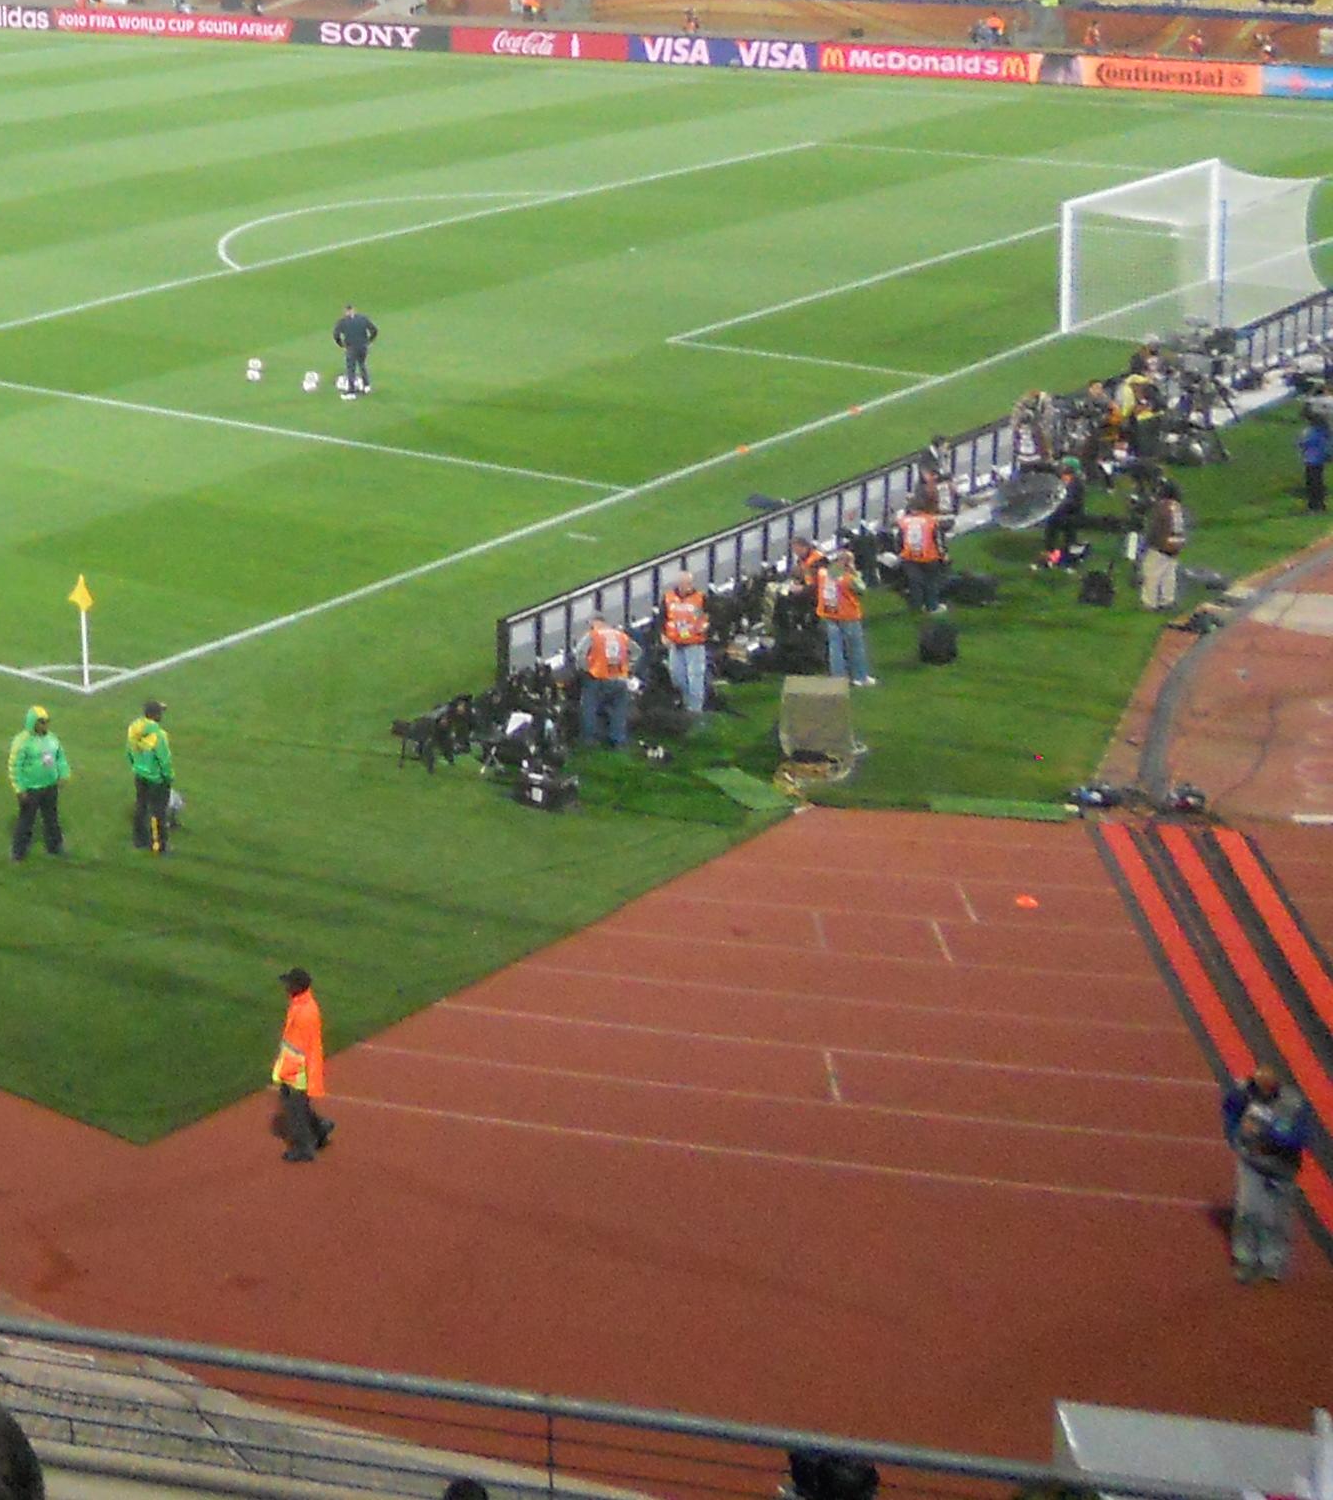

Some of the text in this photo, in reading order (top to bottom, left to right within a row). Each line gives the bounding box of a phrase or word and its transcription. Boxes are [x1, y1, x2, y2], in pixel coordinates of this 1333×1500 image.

[58, 13, 287, 37] 2010 FIFA WORLD CUP SOUTH AFRICA
[320, 21, 420, 48] SONY
[642, 36, 710, 65] VISA
[737, 41, 808, 70] VISA
[849, 49, 999, 75] McDonald's
[1096, 62, 1223, 88] Continental
